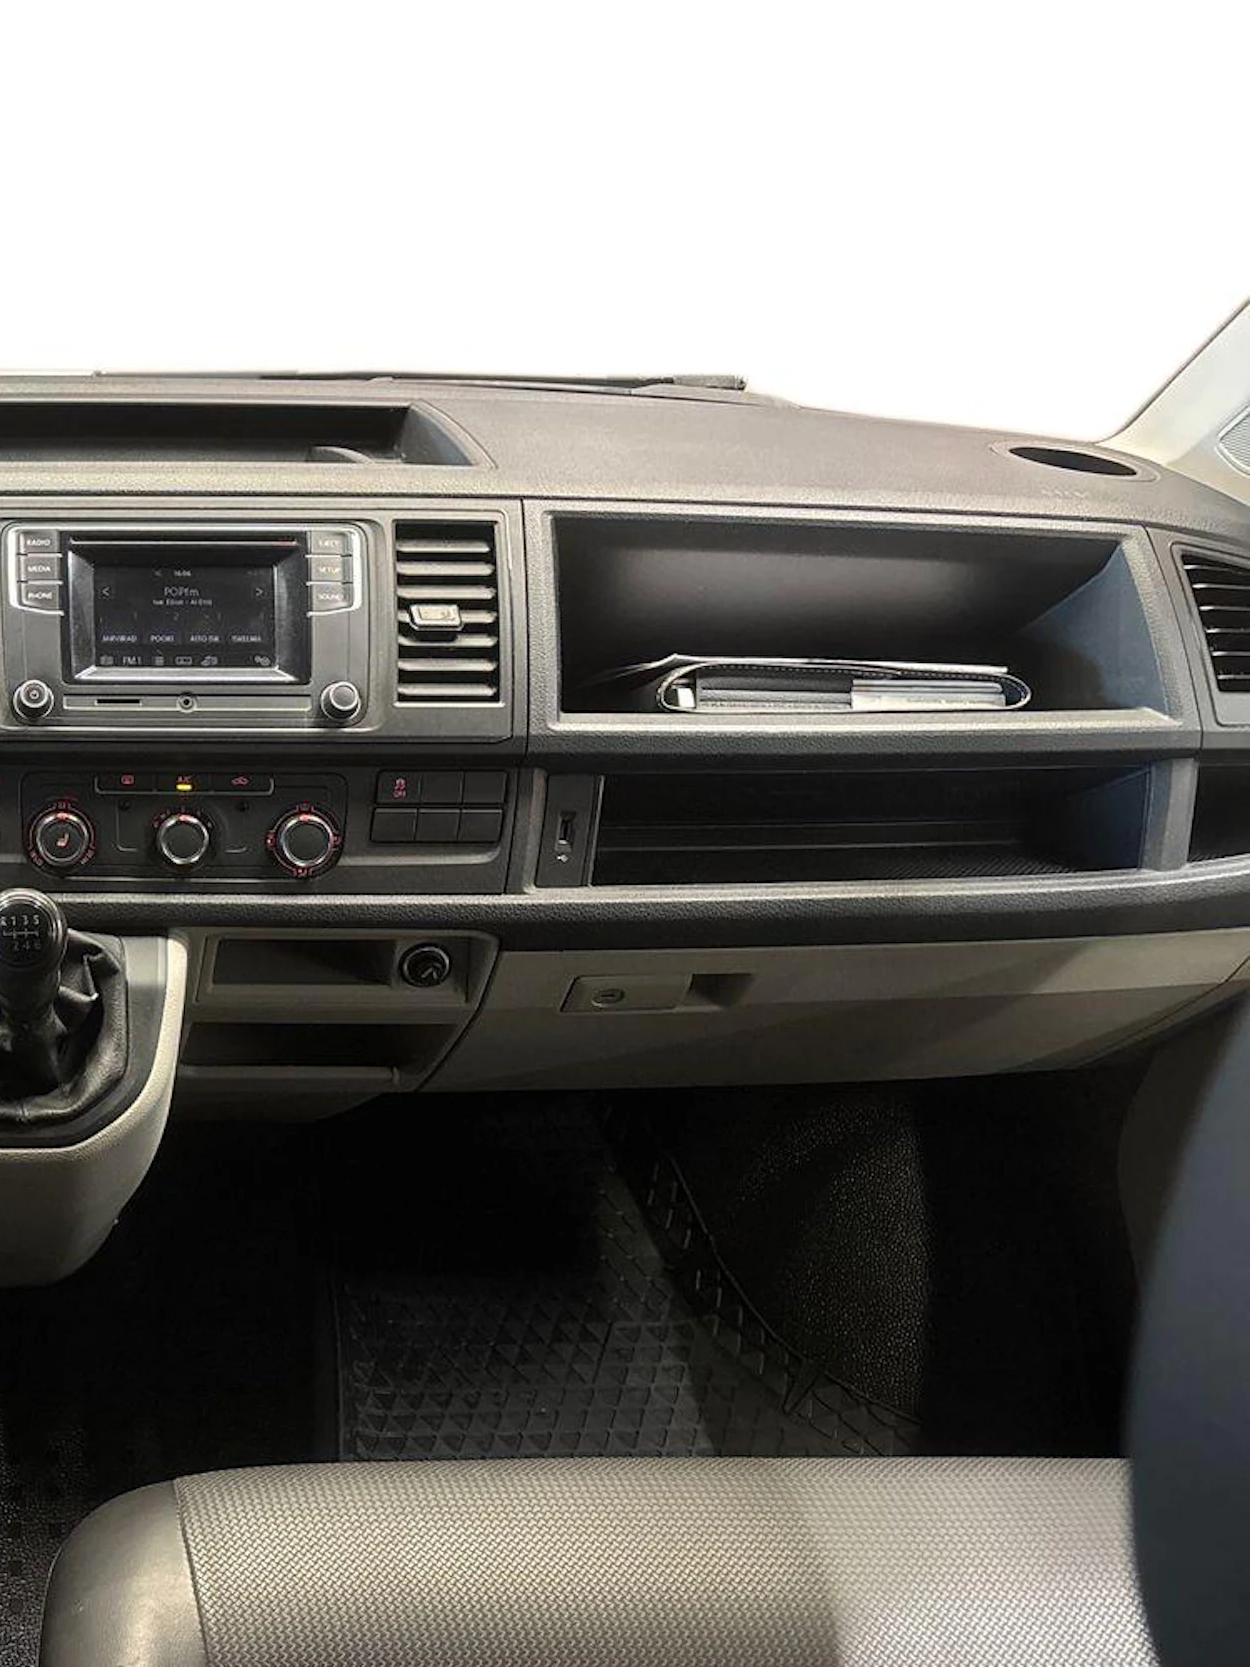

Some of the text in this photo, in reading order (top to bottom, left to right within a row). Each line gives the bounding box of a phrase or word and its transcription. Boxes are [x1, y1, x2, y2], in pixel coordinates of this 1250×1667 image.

[26, 538, 51, 547] RADIO
[27, 564, 51, 573] MEDIA
[27, 591, 53, 600] PHONE
[10, 916, 17, 926] 1
[22, 914, 30, 925] 3
[32, 914, 40, 925] 5
